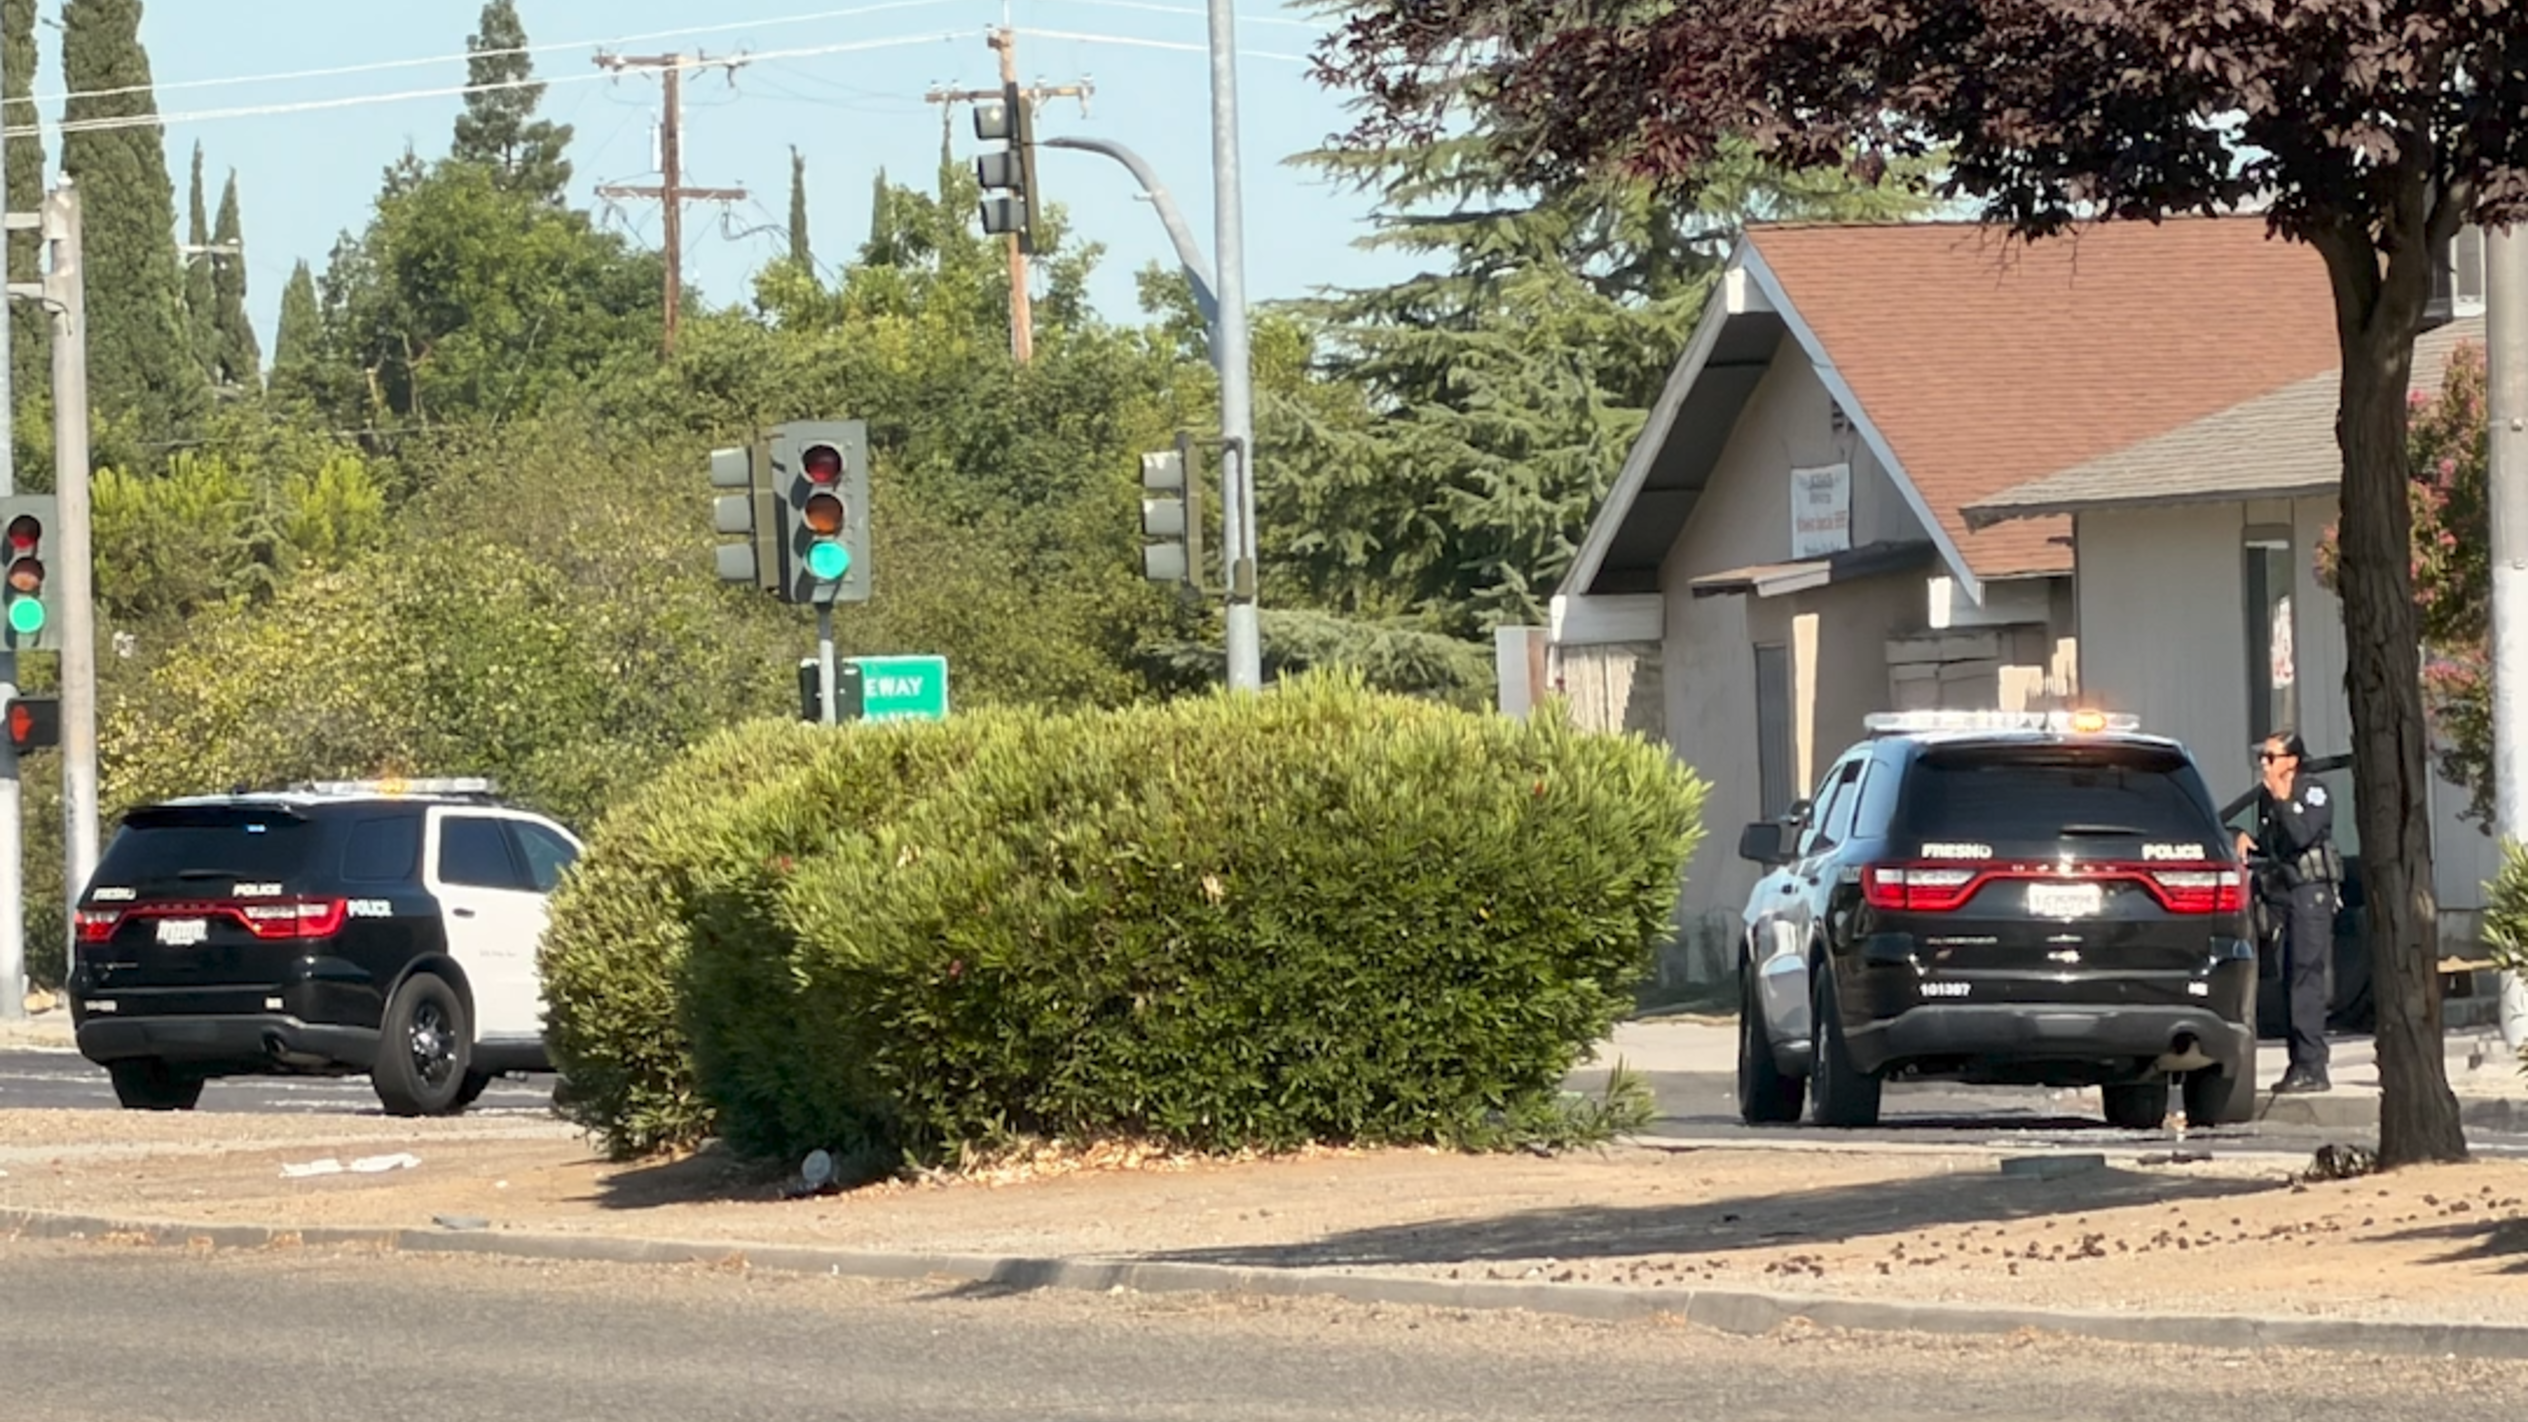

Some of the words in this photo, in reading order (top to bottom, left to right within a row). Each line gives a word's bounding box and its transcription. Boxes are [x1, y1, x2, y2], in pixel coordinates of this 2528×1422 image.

[865, 676, 924, 697] EWAY
[1921, 843, 1993, 859] FRESNO
[2142, 843, 2205, 860] POLICE
[233, 884, 282, 896] POLICE
[347, 899, 393, 917] POLICE
